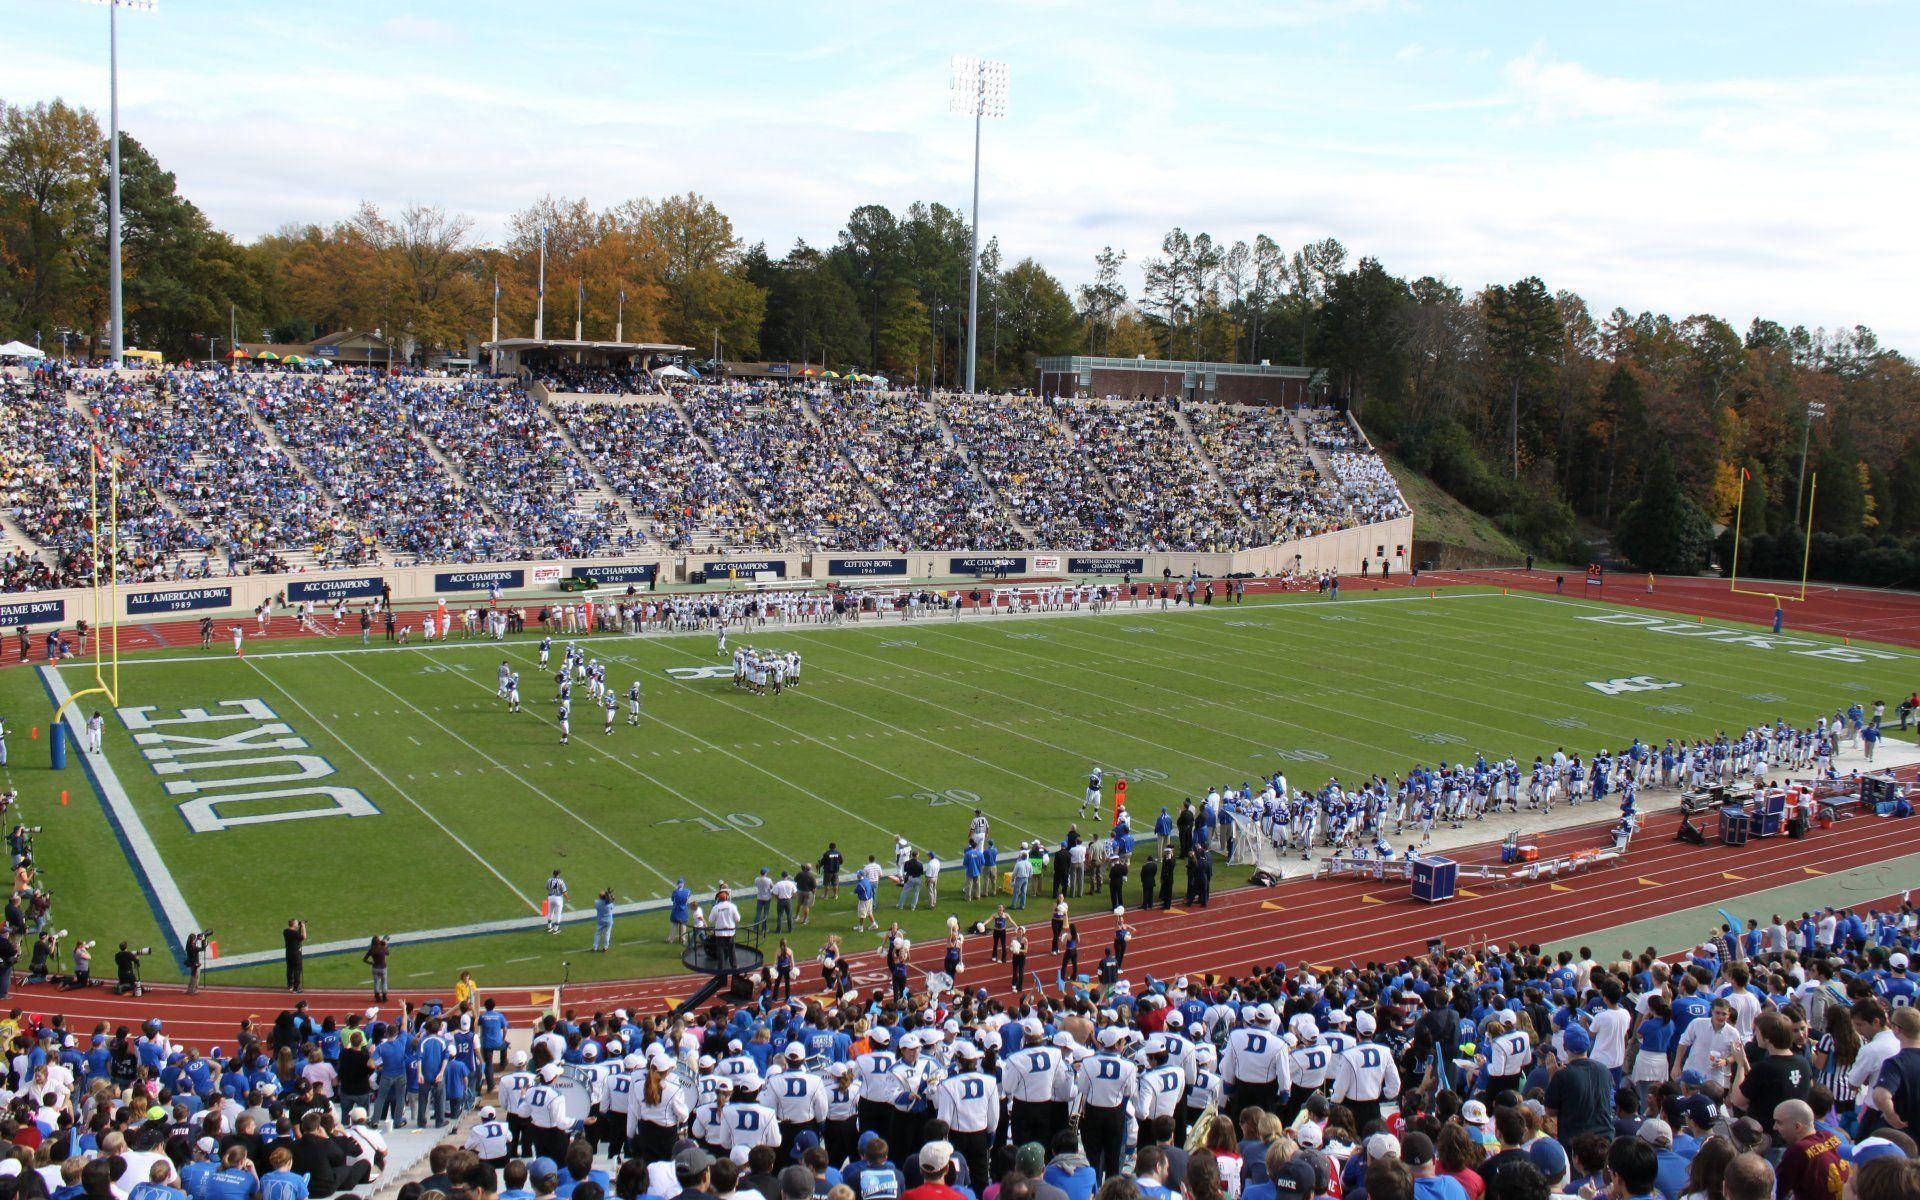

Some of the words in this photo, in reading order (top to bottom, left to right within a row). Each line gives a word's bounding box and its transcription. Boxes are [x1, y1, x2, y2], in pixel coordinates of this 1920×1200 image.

[535, 569, 560, 578] ESPN
[586, 568, 602, 576] ACC
[603, 567, 644, 575] CHAMPIONS
[712, 563, 728, 571] ACC
[730, 562, 768, 570] CHAMPIONS
[303, 582, 319, 591] ACC
[320, 579, 370, 590] CHAMPIONS
[449, 574, 466, 583] ACC
[467, 571, 512, 581] CHAMPIONS
[131, 595, 149, 604] ALL
[151, 591, 202, 602] AMERICAN
[203, 588, 229, 599] BOWL
[328, 590, 347, 598] 1989
[0, 604, 29, 616] FAME
[31, 602, 60, 613] BOWL
[171, 601, 191, 609] 1989
[1573, 613, 1900, 663] DUKE
[114, 698, 384, 834] DUKE
[1353, 849, 1365, 859] 96
[457, 1042, 469, 1053] 12
[1244, 1033, 1267, 1055] D
[1325, 1037, 1344, 1054] D
[1509, 1037, 1526, 1056] D
[873, 1056, 892, 1074] D
[1028, 1051, 1051, 1074] D
[1306, 1051, 1326, 1071] D
[1360, 1047, 1381, 1068] D
[730, 1061, 744, 1075] D
[1097, 1060, 1121, 1081] D
[616, 1077, 631, 1094] D
[784, 1077, 807, 1098] D
[959, 1079, 985, 1100] D
[1160, 1072, 1179, 1093] D
[533, 1089, 547, 1107] D
[736, 1109, 760, 1131] D
[487, 1123, 502, 1139] D
[1277, 1177, 1297, 1190] DUKE
